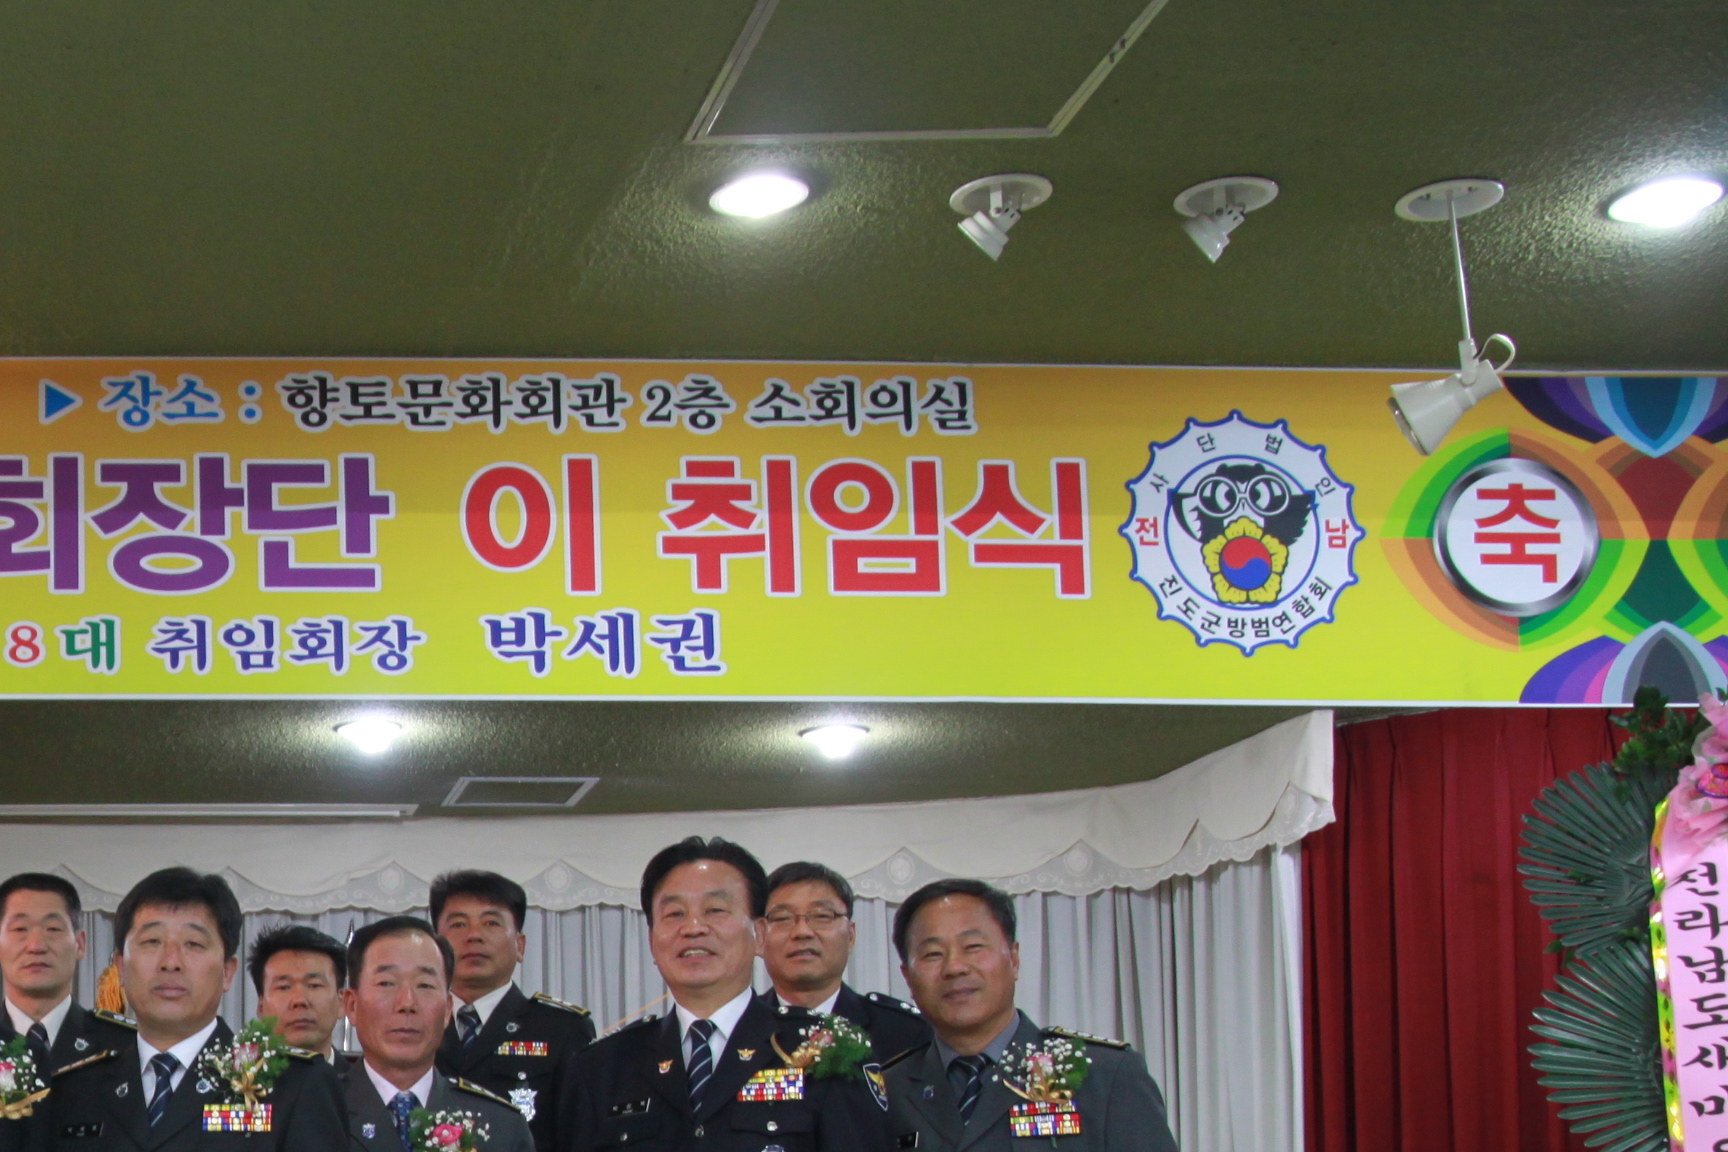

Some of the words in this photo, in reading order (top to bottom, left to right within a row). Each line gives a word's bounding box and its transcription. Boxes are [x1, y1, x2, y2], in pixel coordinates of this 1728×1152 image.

[104, 376, 220, 427] 장소
[280, 377, 628, 429] 향토문화회관
[645, 378, 730, 430] 2층
[750, 379, 973, 431] 소회의실
[661, 459, 1085, 595] 취임식
[1472, 482, 1560, 584] 축
[1158, 574, 1333, 639] 진도군방범연합회
[151, 618, 421, 672] 취임회장
[488, 612, 721, 674] 박세권
